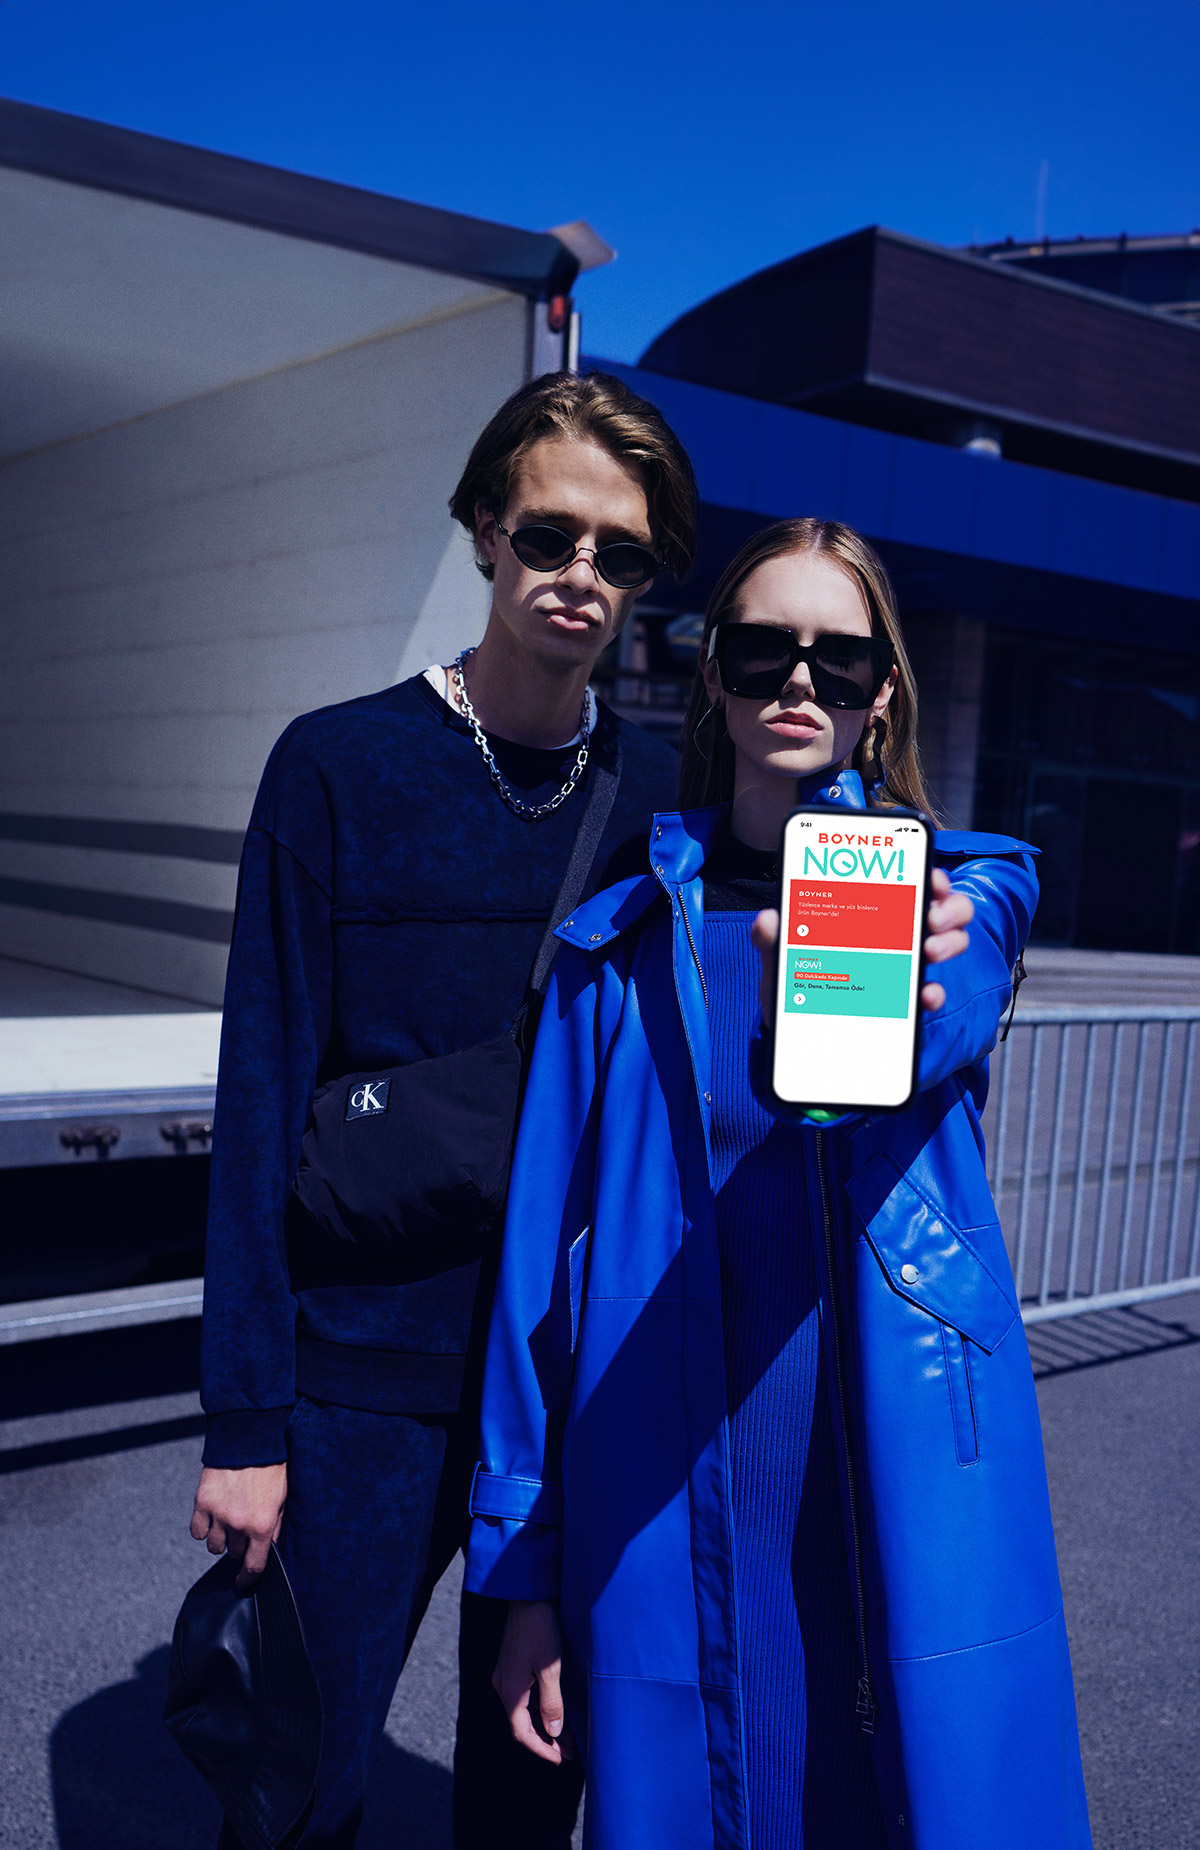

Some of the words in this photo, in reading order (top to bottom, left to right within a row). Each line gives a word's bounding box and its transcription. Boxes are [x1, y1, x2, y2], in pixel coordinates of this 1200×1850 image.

[818, 833, 893, 846] BOYNER
[804, 846, 904, 881] NOW!
[795, 961, 822, 970] NOW!
